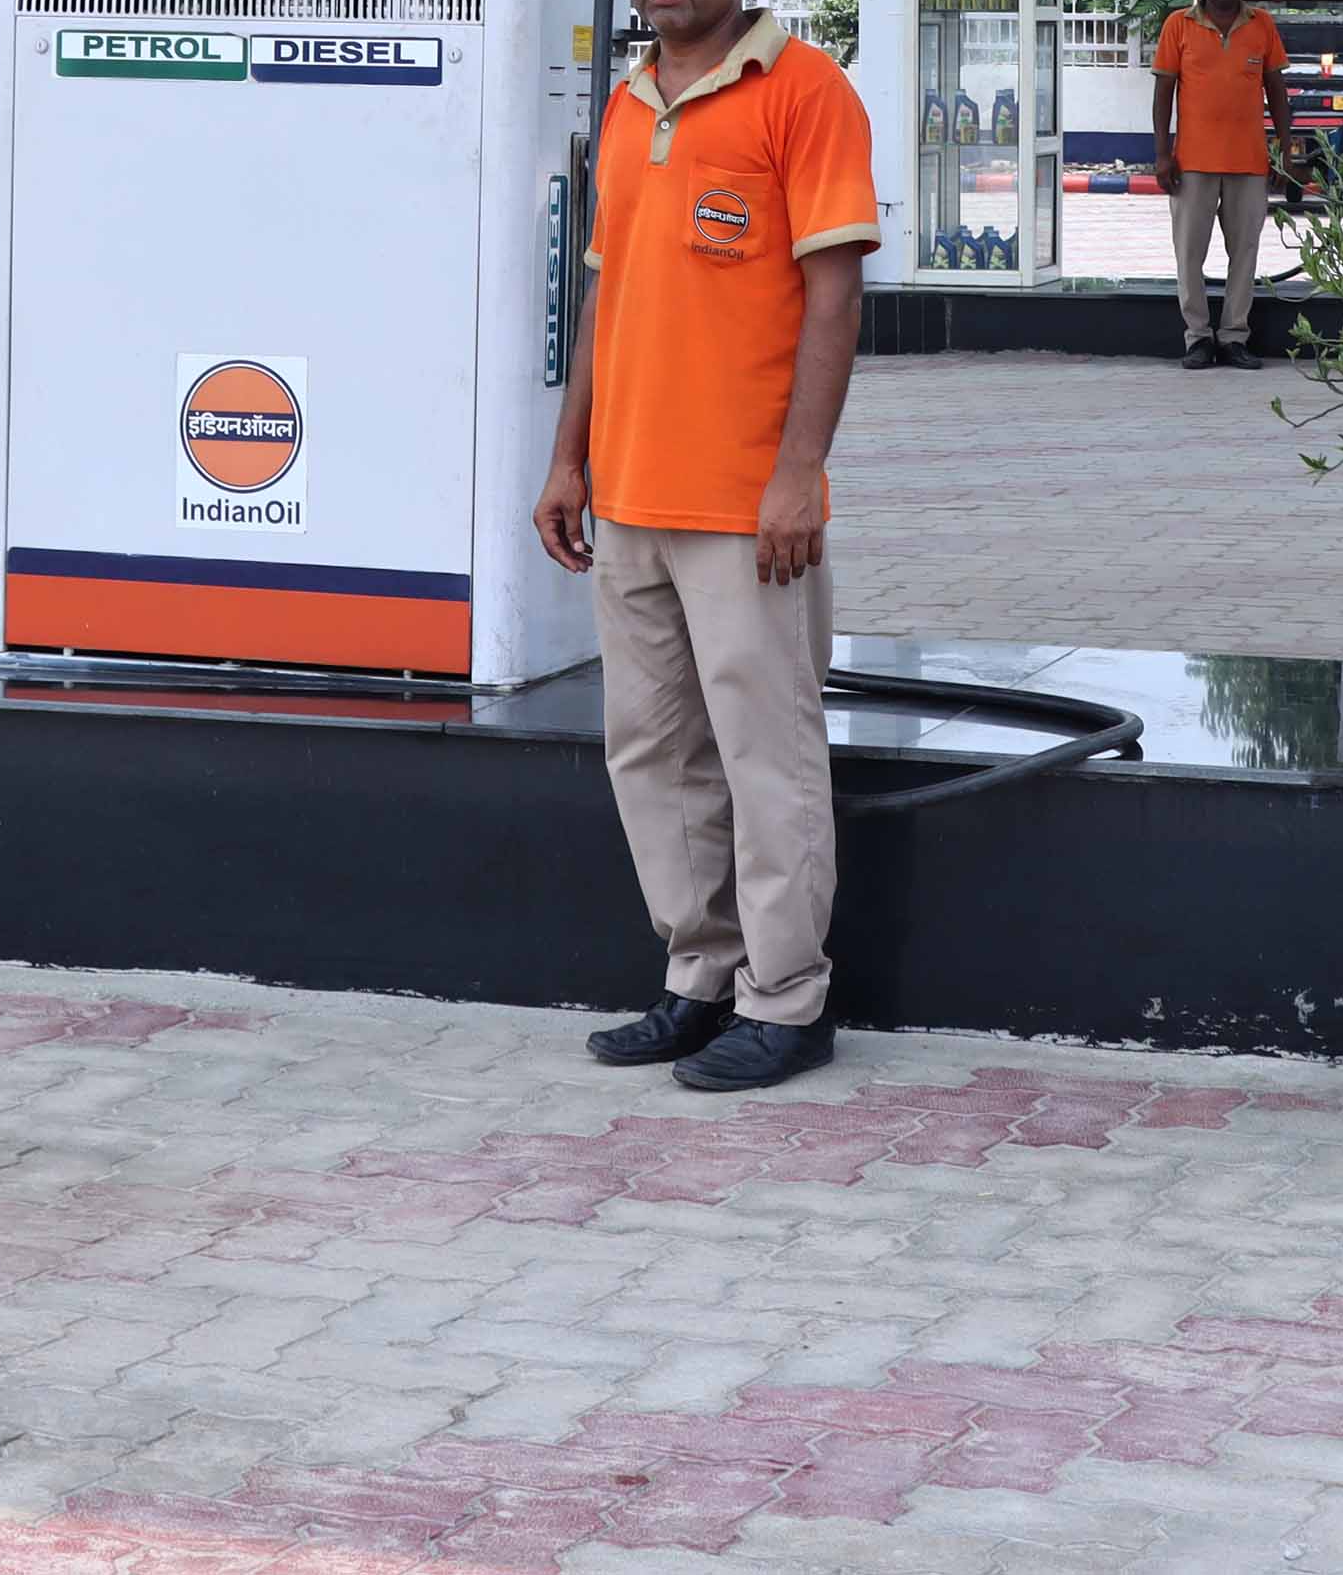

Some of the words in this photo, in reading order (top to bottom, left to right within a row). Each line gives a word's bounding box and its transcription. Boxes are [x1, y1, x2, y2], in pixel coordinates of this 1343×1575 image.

[83, 35, 222, 60] PETROL
[274, 40, 416, 65] DIESEL
[691, 241, 744, 261] IndianOil
[547, 187, 560, 371] DIESEL
[188, 412, 294, 438] इंडियनऑयल
[182, 497, 301, 525] IndianOil
